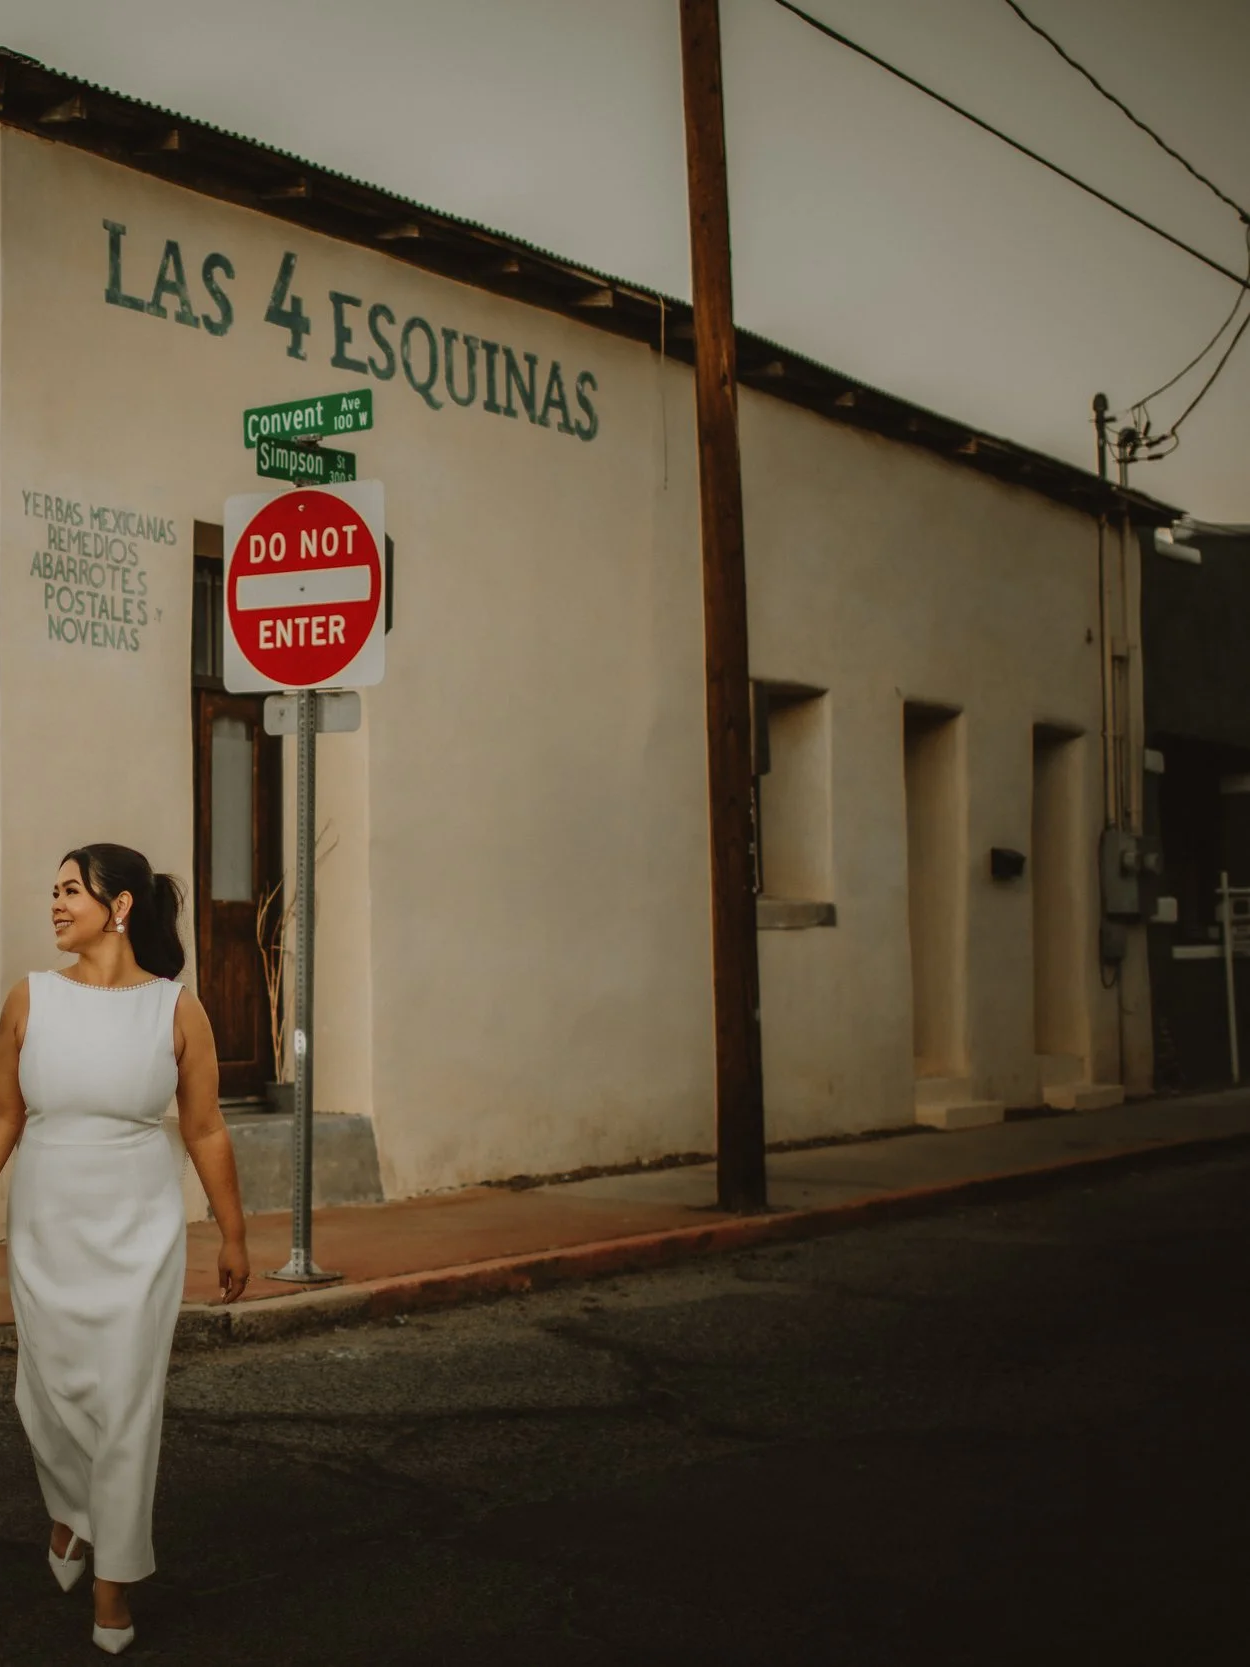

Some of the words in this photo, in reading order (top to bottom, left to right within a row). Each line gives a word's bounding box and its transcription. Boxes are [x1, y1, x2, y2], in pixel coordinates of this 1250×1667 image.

[102, 218, 236, 336] LAS
[264, 250, 310, 361] 4
[329, 290, 599, 442] ESQUINAS
[248, 401, 324, 442] Convent
[341, 397, 361, 412] Ave
[334, 414, 354, 431] 100
[358, 411, 368, 427] W
[260, 442, 323, 477] Simpson
[337, 454, 346, 470] St
[22, 489, 84, 527] YERBAS
[90, 504, 177, 546] MEXICANAS
[48, 523, 139, 567] REMEDIOS
[249, 532, 286, 564] DO
[300, 524, 358, 560] NOT
[30, 551, 148, 597] ABARROTES
[44, 582, 148, 626] POSTALES
[47, 614, 140, 652] NOVENAS
[258, 614, 346, 650] ENTER
